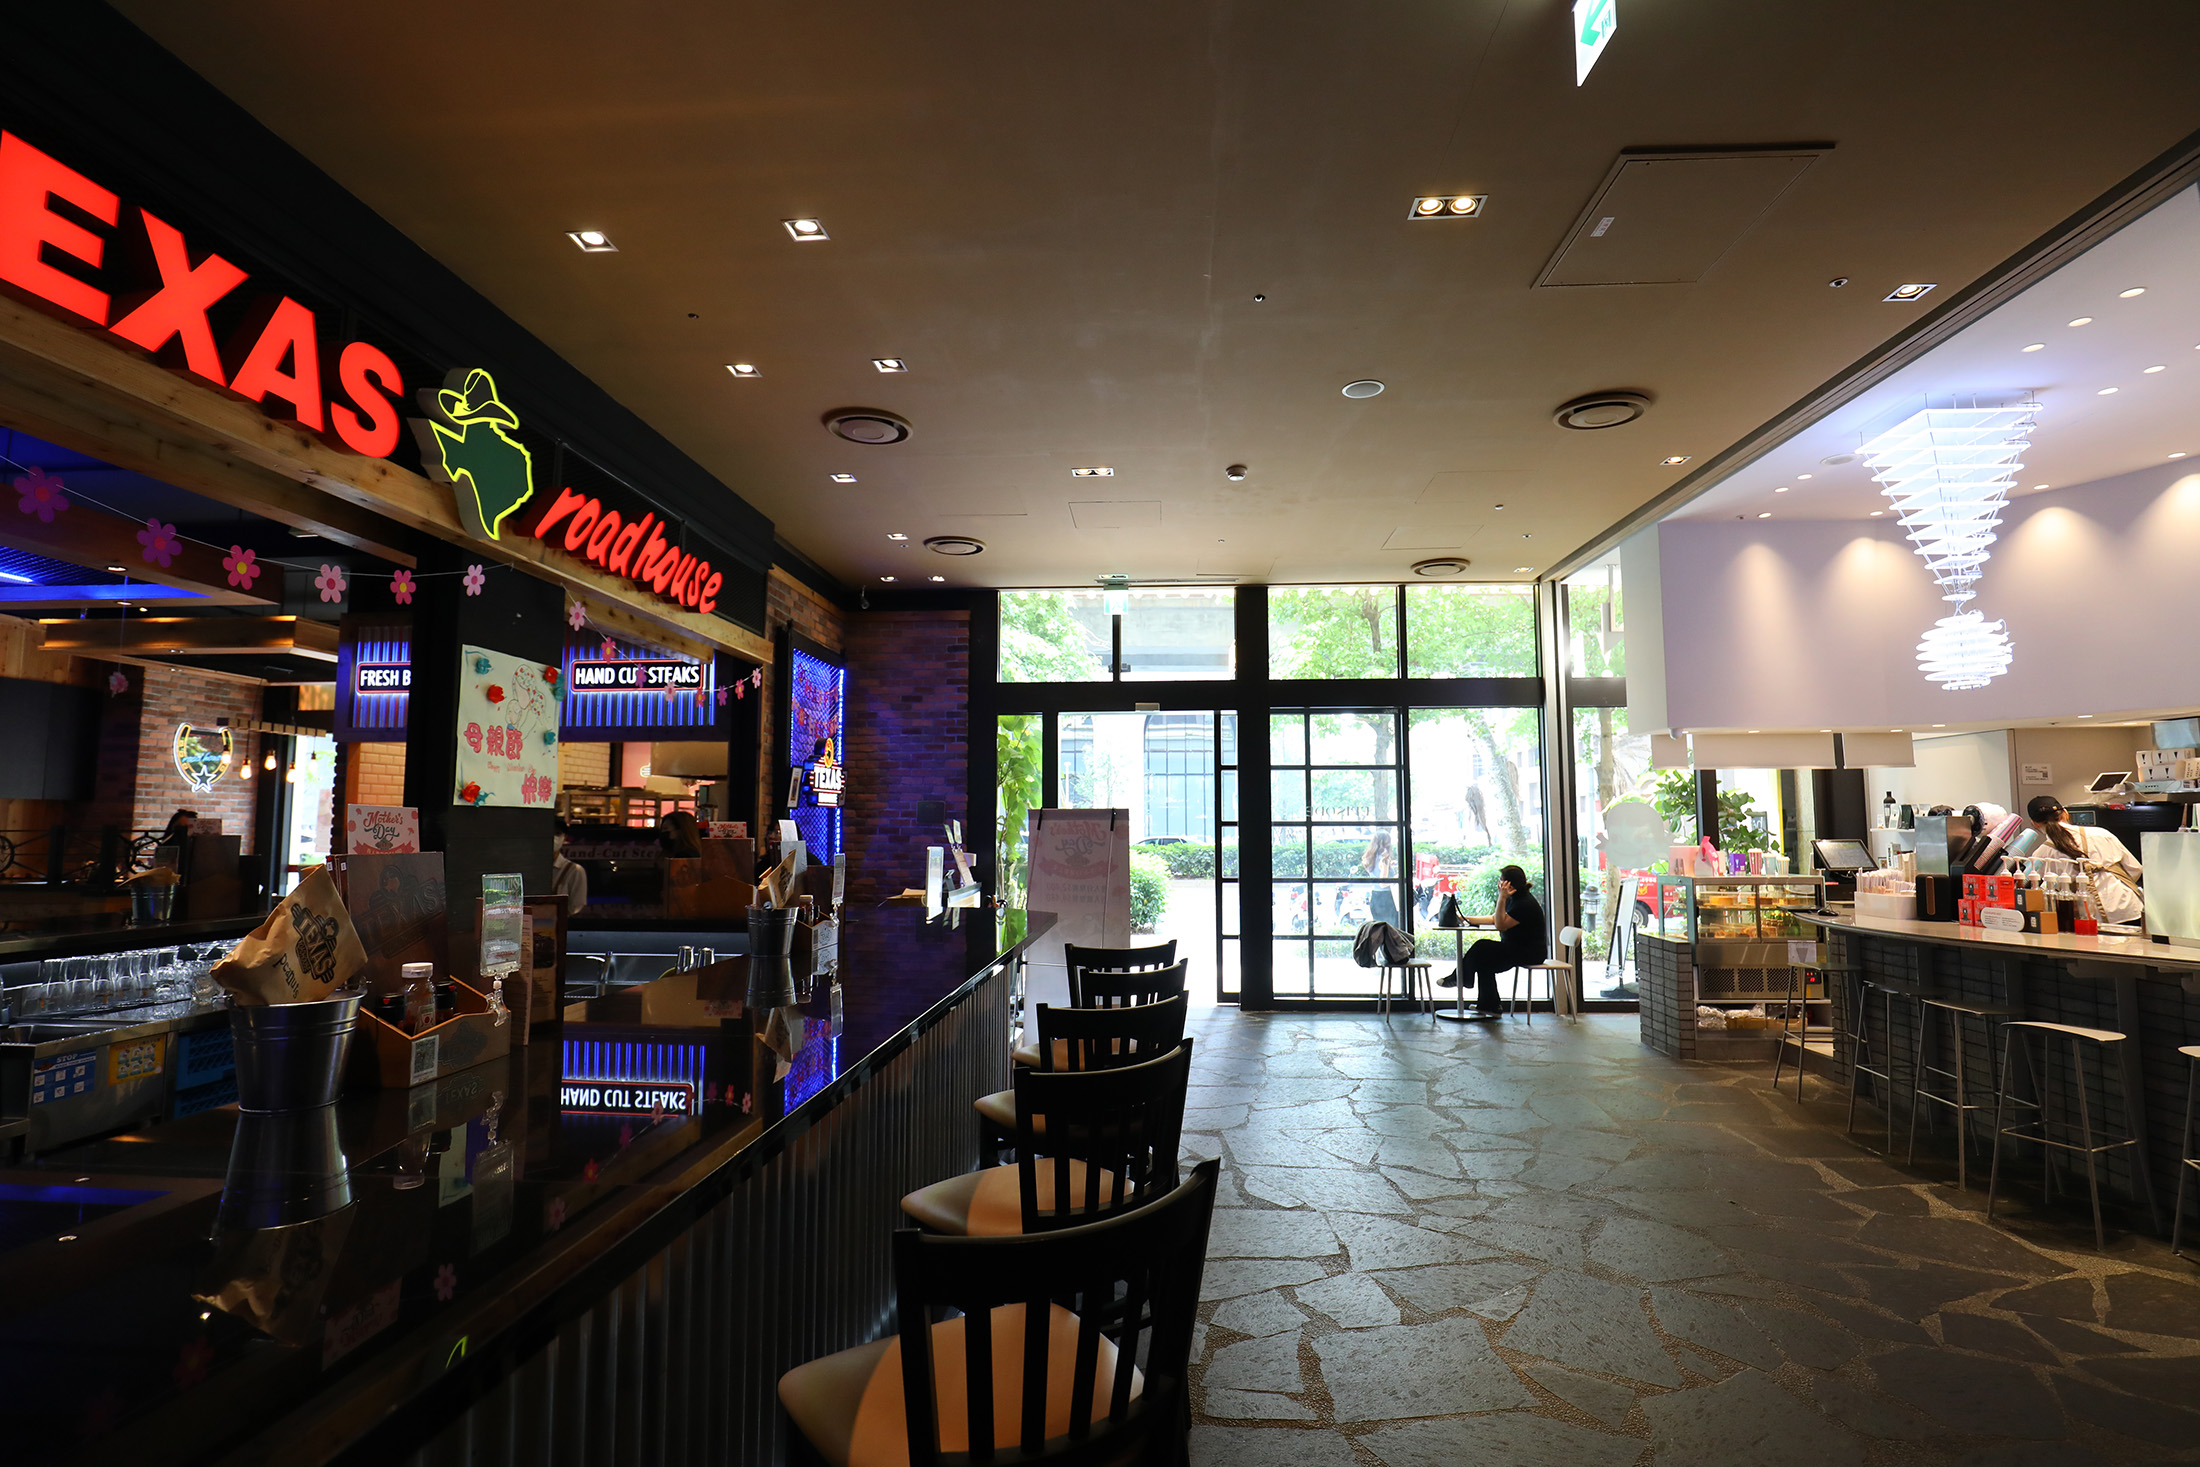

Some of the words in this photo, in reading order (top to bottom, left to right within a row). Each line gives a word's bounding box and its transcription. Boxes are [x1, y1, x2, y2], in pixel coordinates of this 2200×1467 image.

[535, 487, 723, 614] roadhouse
[360, 669, 399, 687] FRESH
[575, 667, 616, 685] HAND
[618, 667, 641, 684] CU
[648, 666, 700, 684] STEAKS
[463, 722, 523, 760] 母親節
[521, 773, 552, 805] 快樂
[813, 766, 842, 790] TEXAS
[363, 809, 403, 828] Mother's
[364, 824, 400, 842] Day
[299, 919, 333, 974] TEXAS
[272, 952, 300, 1000] peanuts
[56, 1053, 79, 1064] STOP
